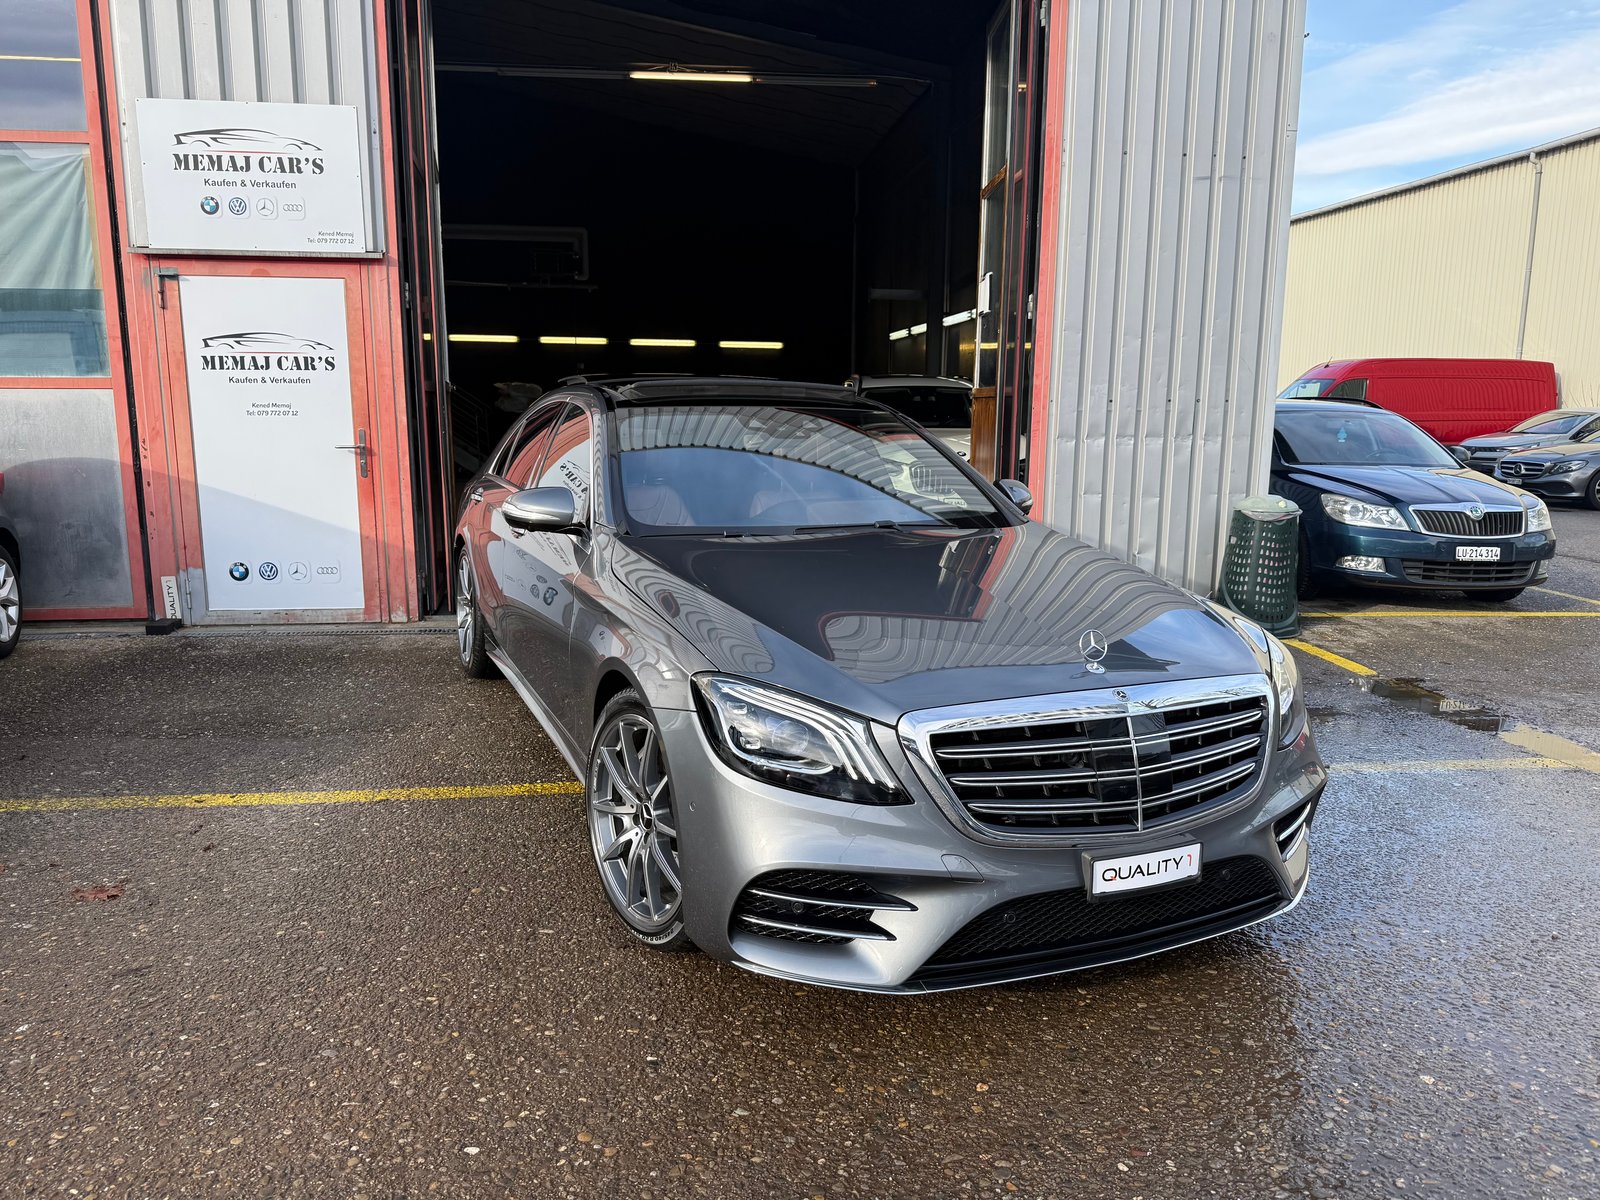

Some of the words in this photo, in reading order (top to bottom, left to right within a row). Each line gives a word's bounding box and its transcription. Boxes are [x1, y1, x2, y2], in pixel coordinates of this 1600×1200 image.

[172, 153, 251, 173] MEMAJ
[258, 155, 325, 175] CAR'S
[203, 178, 237, 188] Kaufen
[240, 179, 247, 188] &
[249, 179, 297, 189] Verkaufen
[201, 355, 270, 371] MEMAJ
[276, 355, 336, 372] CAR'S
[228, 376, 259, 384] Kaufen
[260, 376, 267, 384] &
[269, 376, 311, 385] Verkaufen
[271, 402, 292, 410] Memaj
[1102, 856, 1184, 882] QUALITY
[1187, 853, 1193, 867] 1
